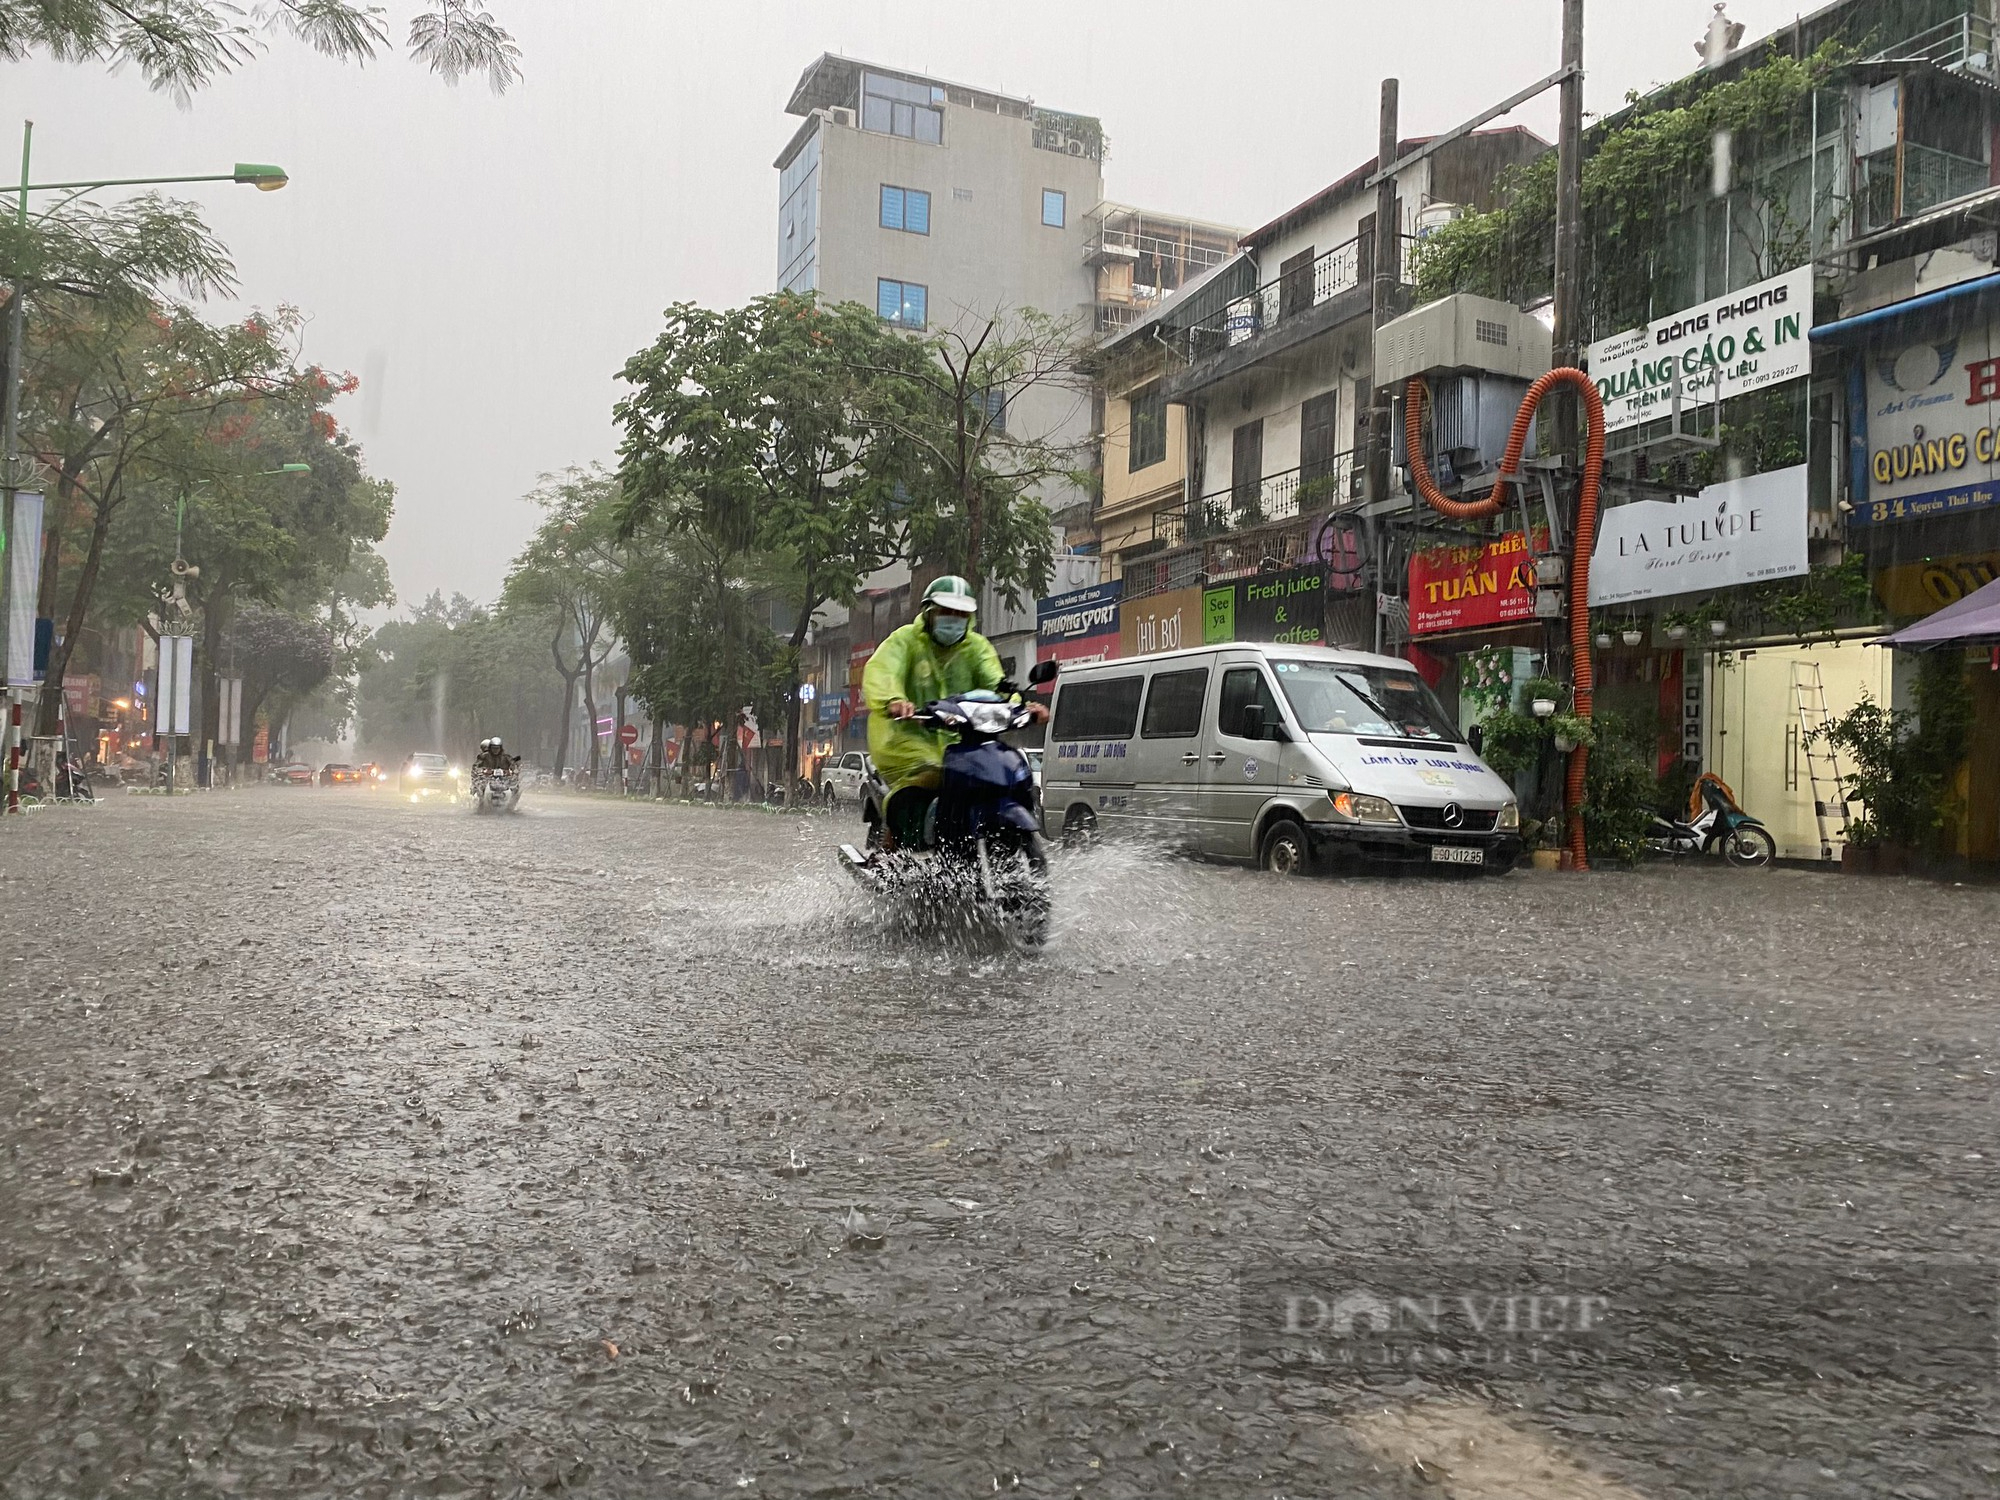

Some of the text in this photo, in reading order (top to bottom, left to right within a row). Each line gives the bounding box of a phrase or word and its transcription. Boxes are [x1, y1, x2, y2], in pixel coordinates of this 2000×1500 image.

[1717, 284, 1788, 324] PHONG
[1612, 348, 1635, 360] QUẢNG
[1635, 341, 1649, 352] CÁO
[1622, 340, 1630, 348] TY
[1596, 312, 1800, 407] QUẢNG CÁO & IN
[1626, 390, 1658, 411] TRÊN
[1661, 382, 1684, 401] MI
[1873, 424, 1968, 485] QUẢNG
[1871, 499, 1907, 522] 34
[1619, 532, 1649, 558] LA
[1247, 575, 1320, 602] Fresh juice
[1425, 564, 1498, 604] TUẤN
[1210, 598, 1229, 612] See
[1275, 605, 1288, 624] &
[1213, 614, 1226, 629] ya
[1273, 625, 1319, 644] coffee
[1361, 751, 1486, 774] LÀM LỐP LƯU ĐỘNG
